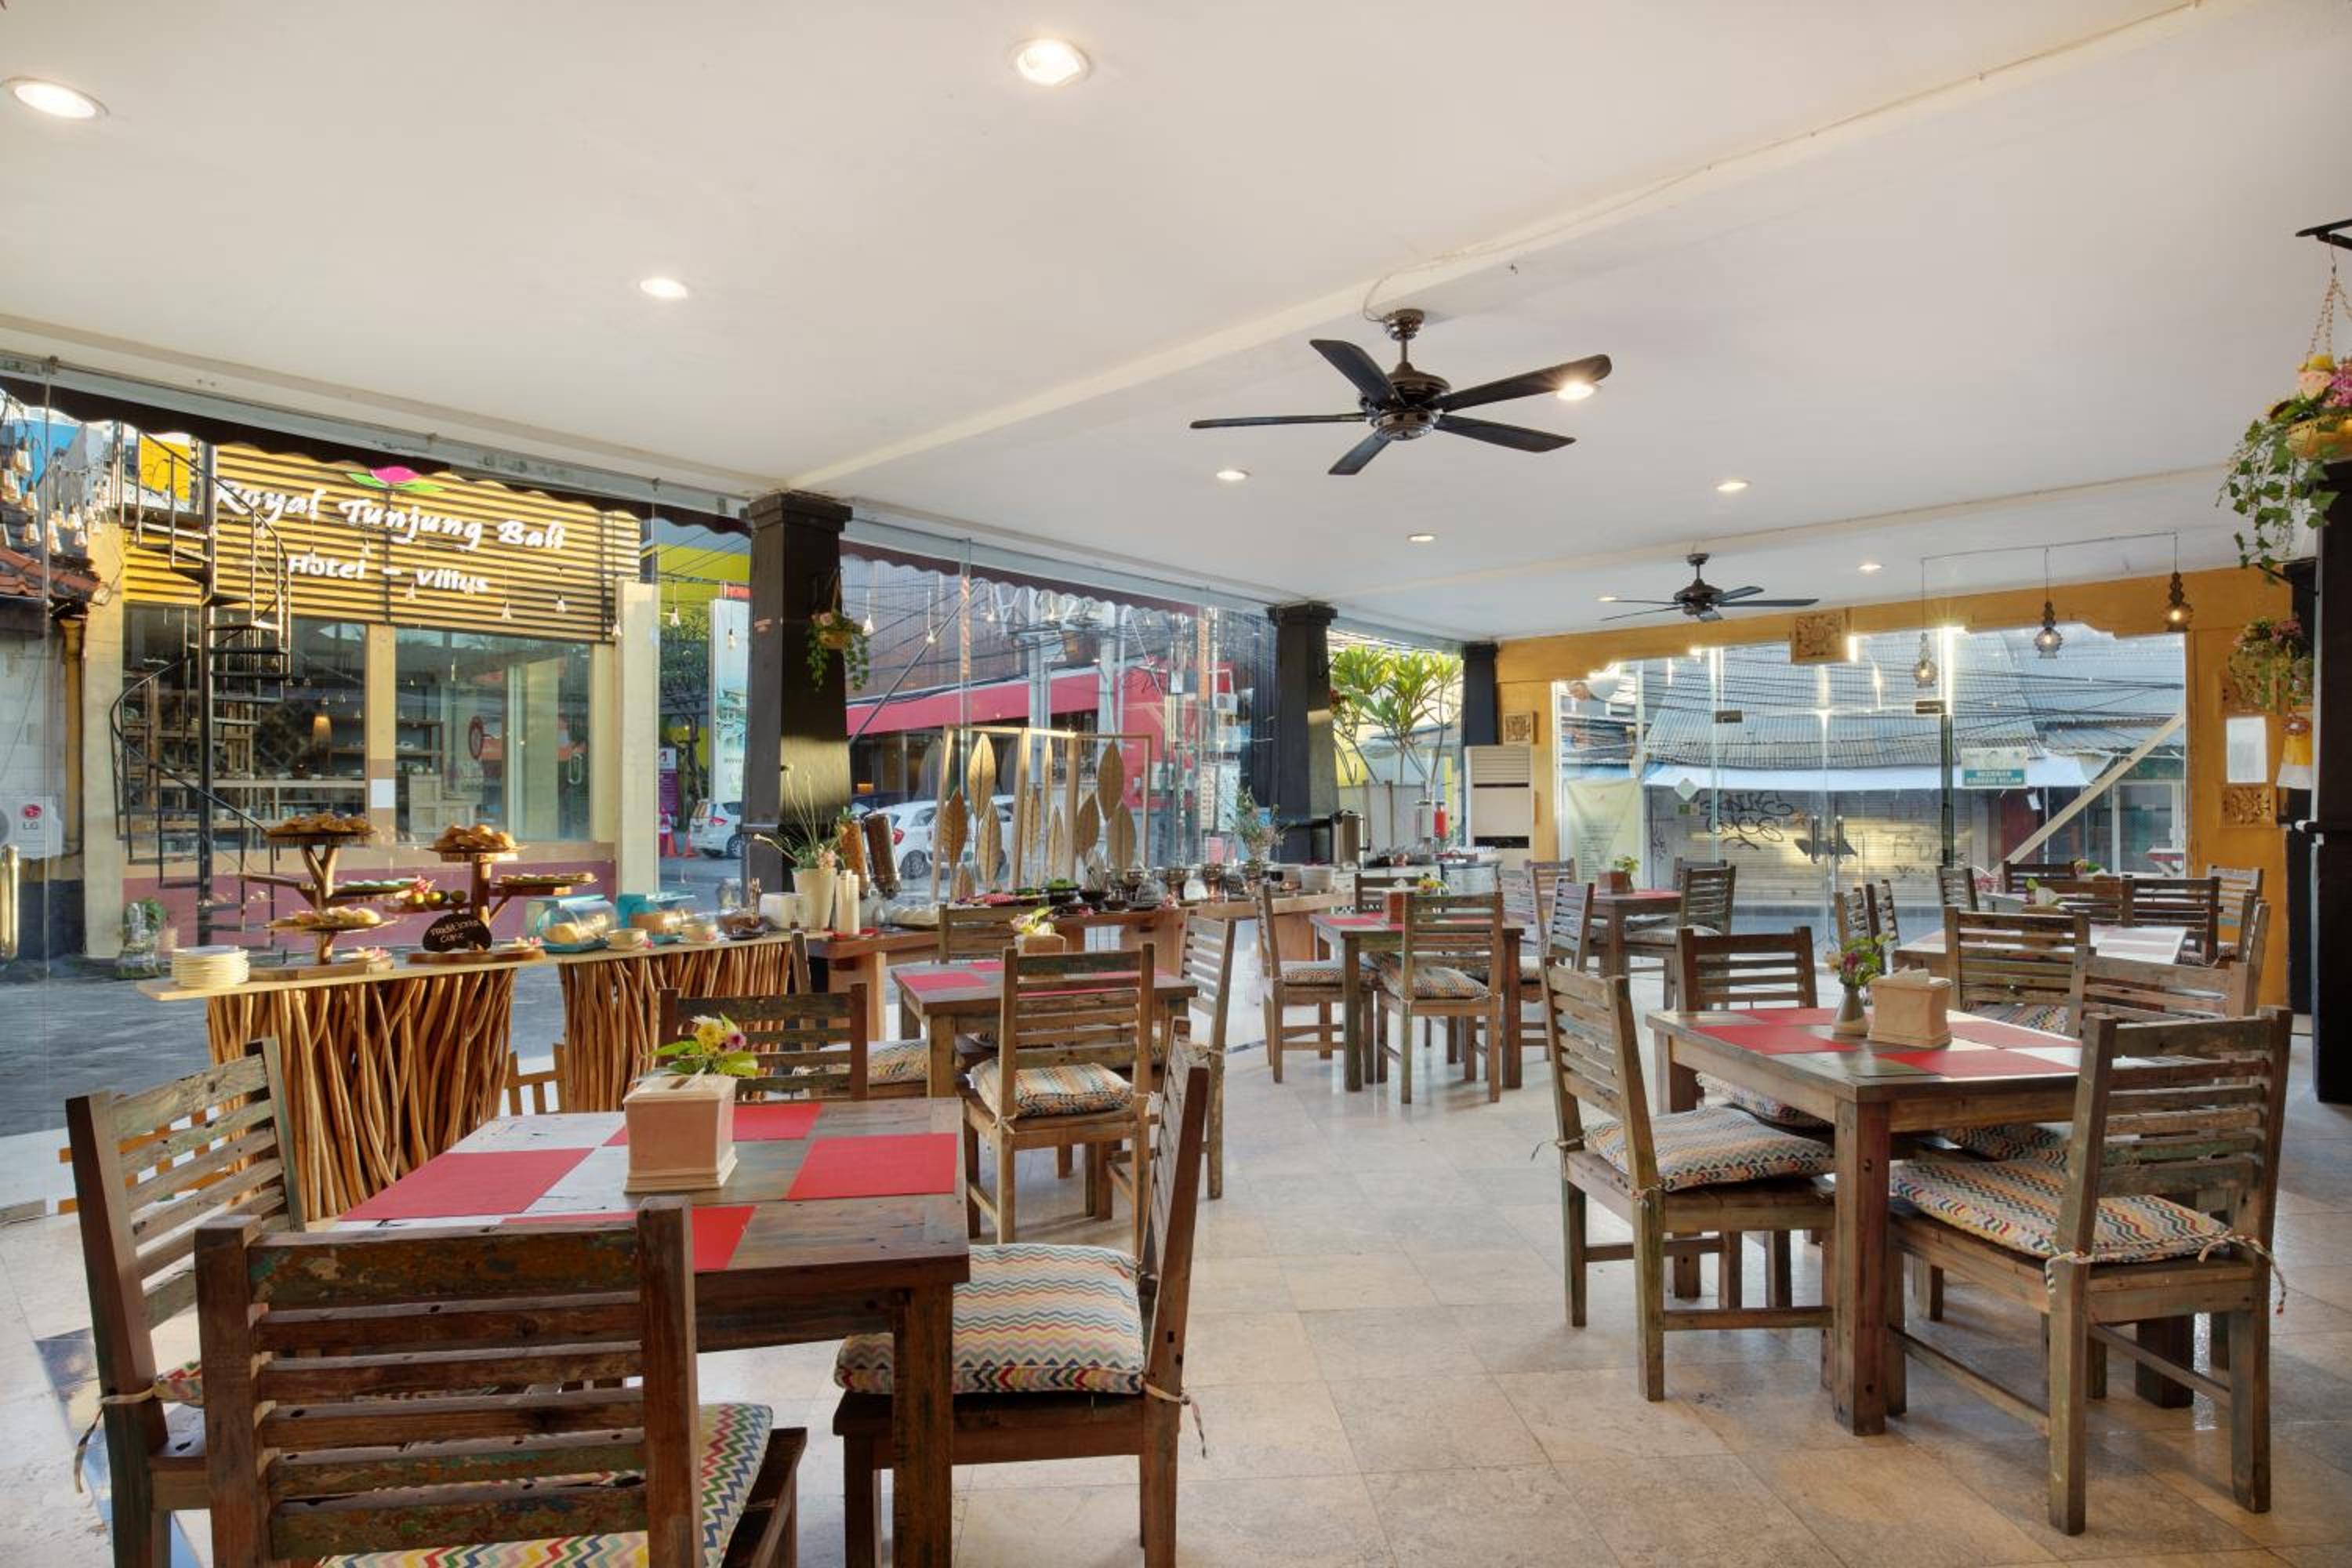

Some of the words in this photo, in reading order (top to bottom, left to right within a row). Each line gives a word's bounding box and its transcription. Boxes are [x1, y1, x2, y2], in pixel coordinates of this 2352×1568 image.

[339, 498, 483, 552] Tunjung
[496, 520, 565, 549] Bali
[288, 553, 365, 579] Hotel
